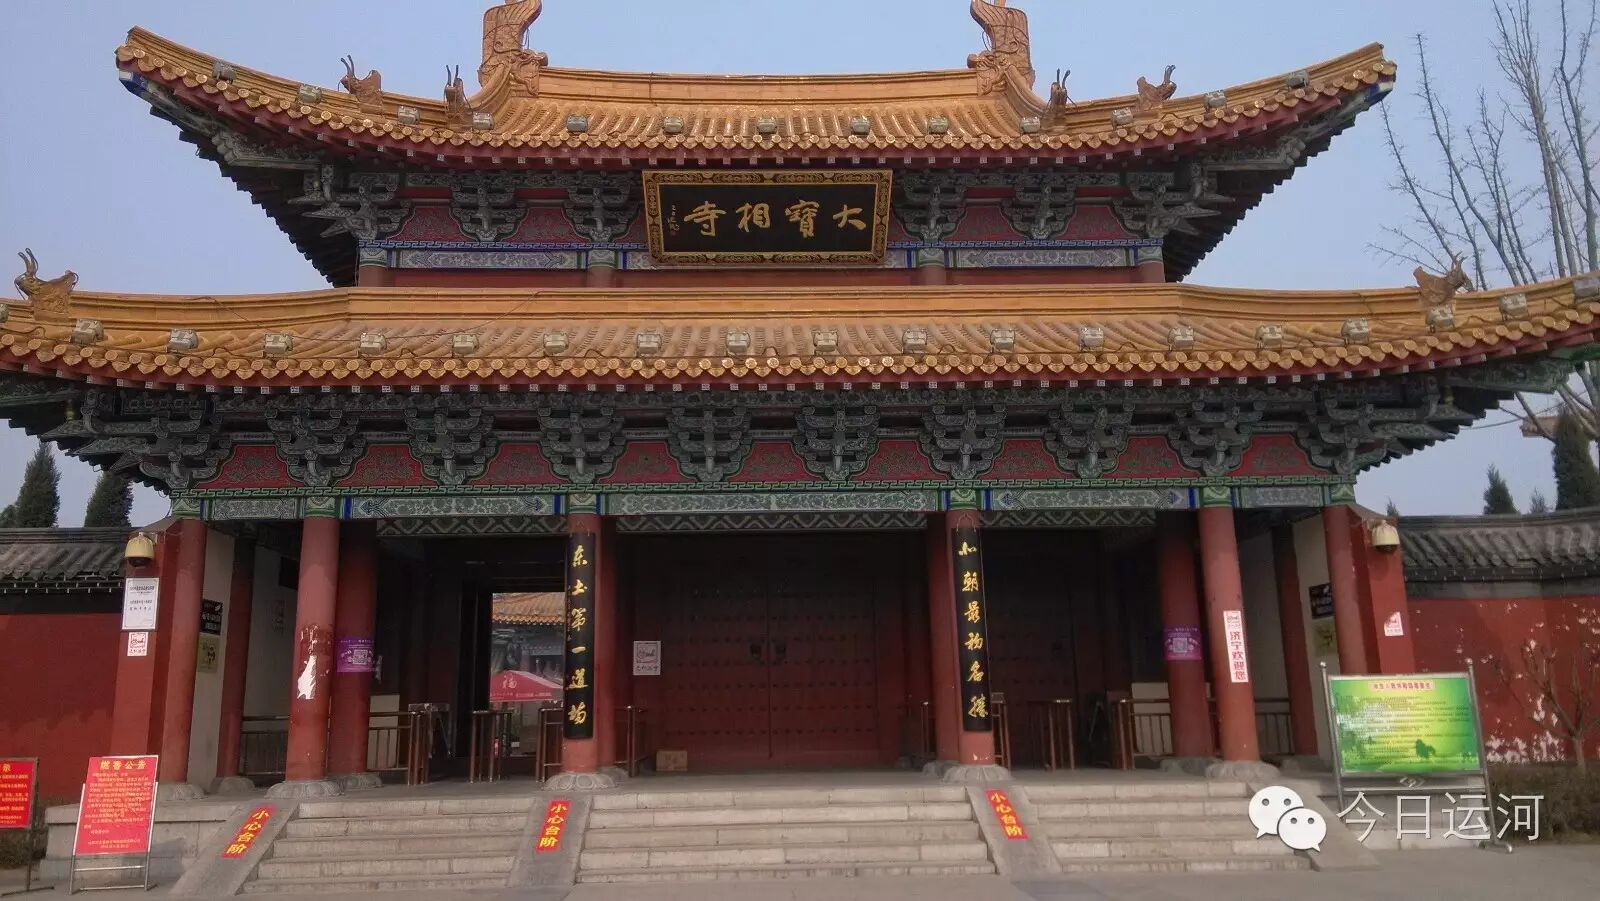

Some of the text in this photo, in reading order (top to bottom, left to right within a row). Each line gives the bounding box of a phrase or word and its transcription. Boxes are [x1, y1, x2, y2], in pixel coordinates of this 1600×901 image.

[226, 810, 270, 854] 小心台阶
[538, 803, 568, 848] 小心台阶
[991, 792, 1023, 836] 小心台阶
